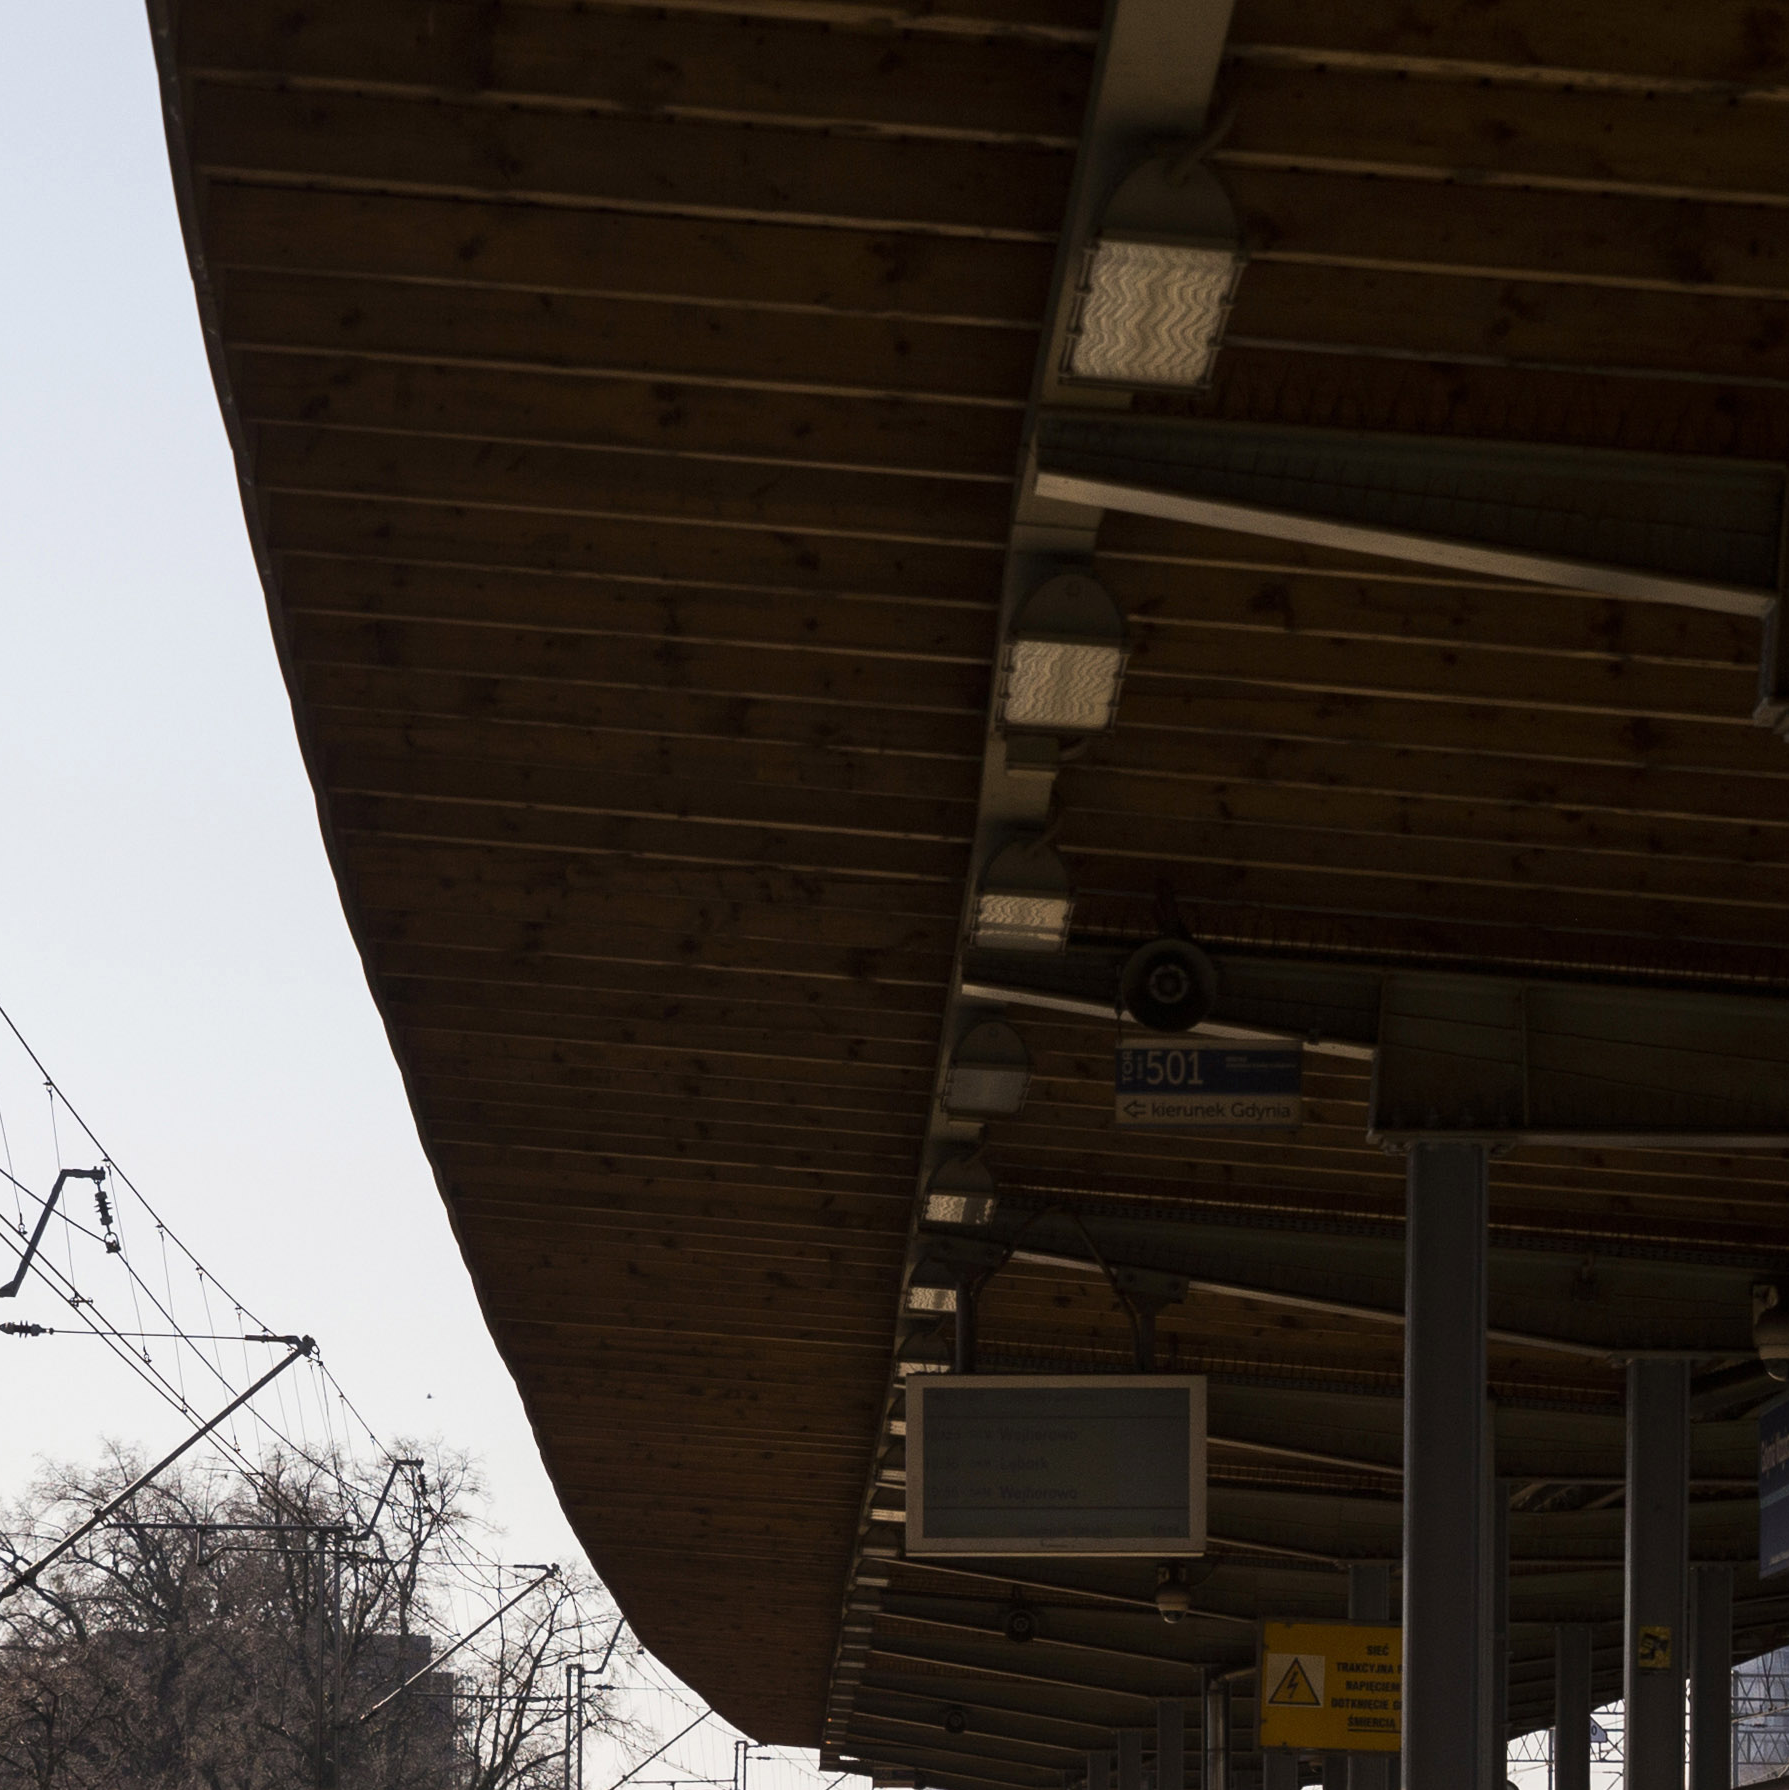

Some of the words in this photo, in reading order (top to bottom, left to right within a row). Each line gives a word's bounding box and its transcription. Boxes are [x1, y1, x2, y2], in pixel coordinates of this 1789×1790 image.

[1145, 1050, 1205, 1086] 501
[1151, 1101, 1225, 1118] kierunek
[1231, 1102, 1291, 1123] Gdynia
[1336, 1661, 1394, 1674] TRAKCYJNA
[1347, 1714, 1396, 1729] ŚMIERCIĄ
